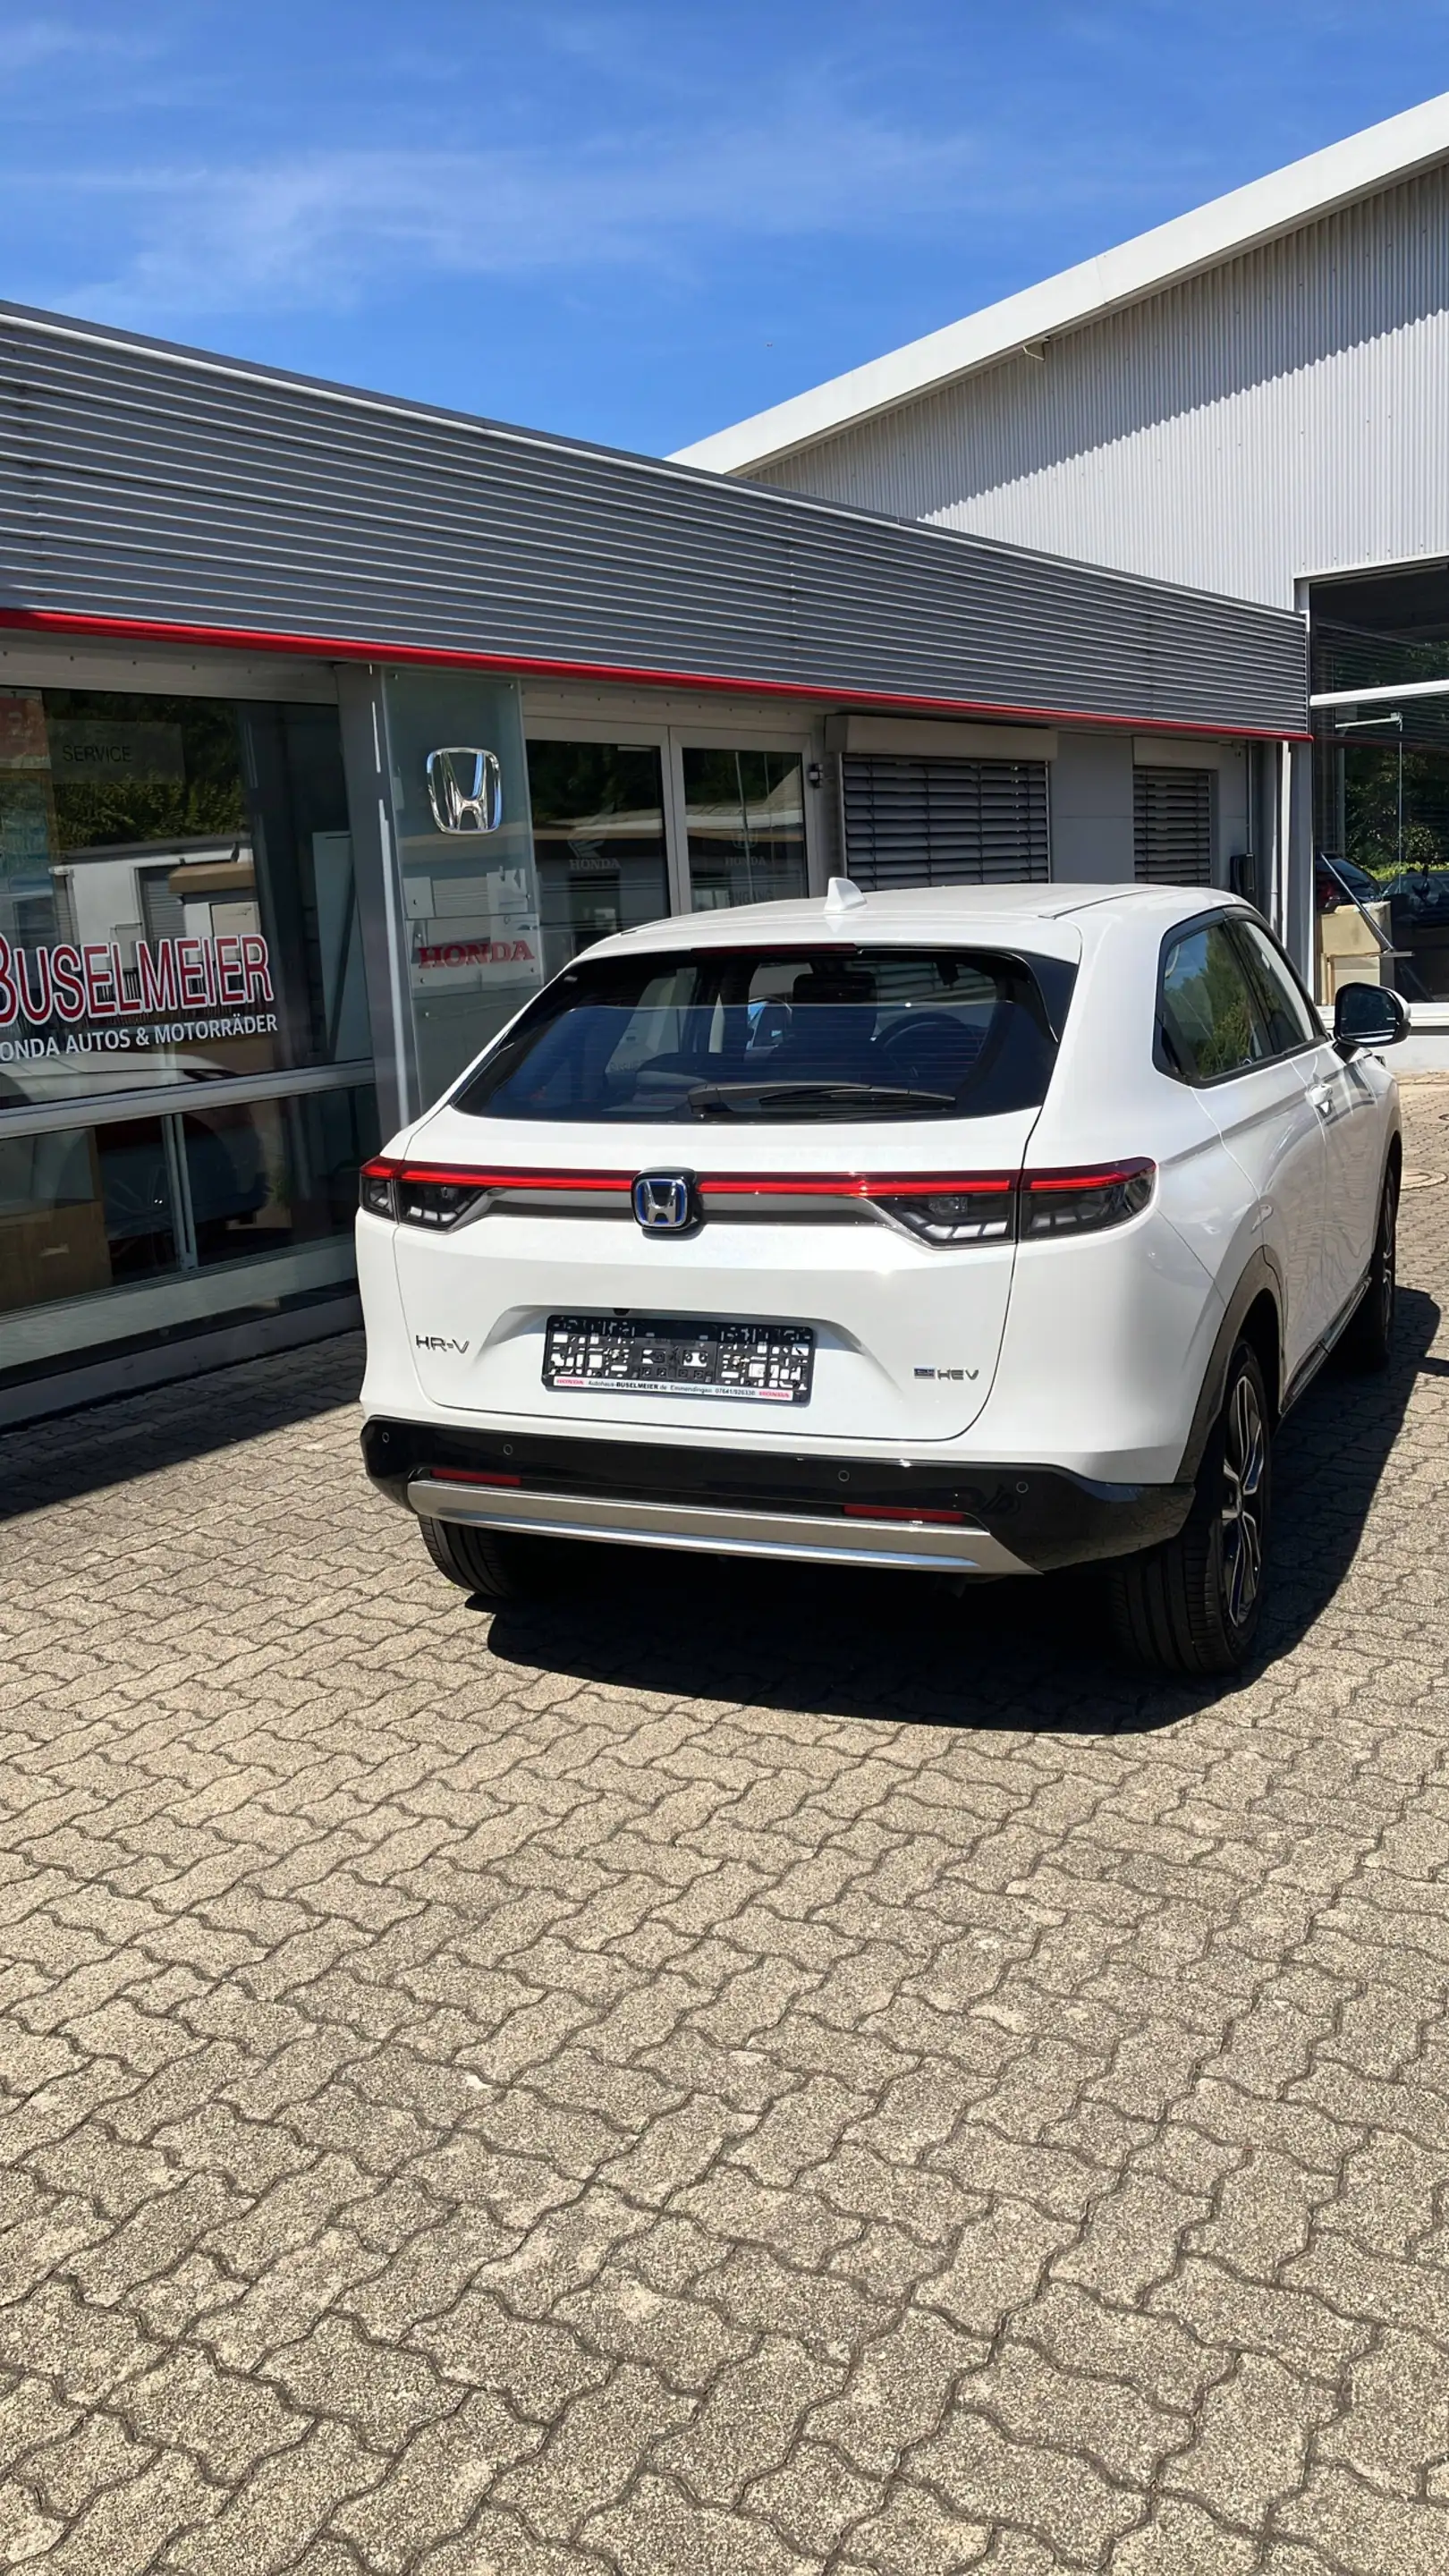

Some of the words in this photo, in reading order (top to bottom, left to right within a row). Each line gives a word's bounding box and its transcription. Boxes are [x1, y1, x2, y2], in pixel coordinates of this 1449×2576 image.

[62, 744, 133, 764] SERVICE
[568, 858, 622, 870] HONDA
[724, 856, 767, 867] HONDA
[418, 940, 535, 969] HONDA
[0, 1037, 60, 1062] ONDA
[65, 1029, 131, 1055] AUTOS
[135, 1026, 149, 1046] &
[155, 1013, 278, 1044] MOTORRÄDER
[416, 1335, 470, 1354] HR-V
